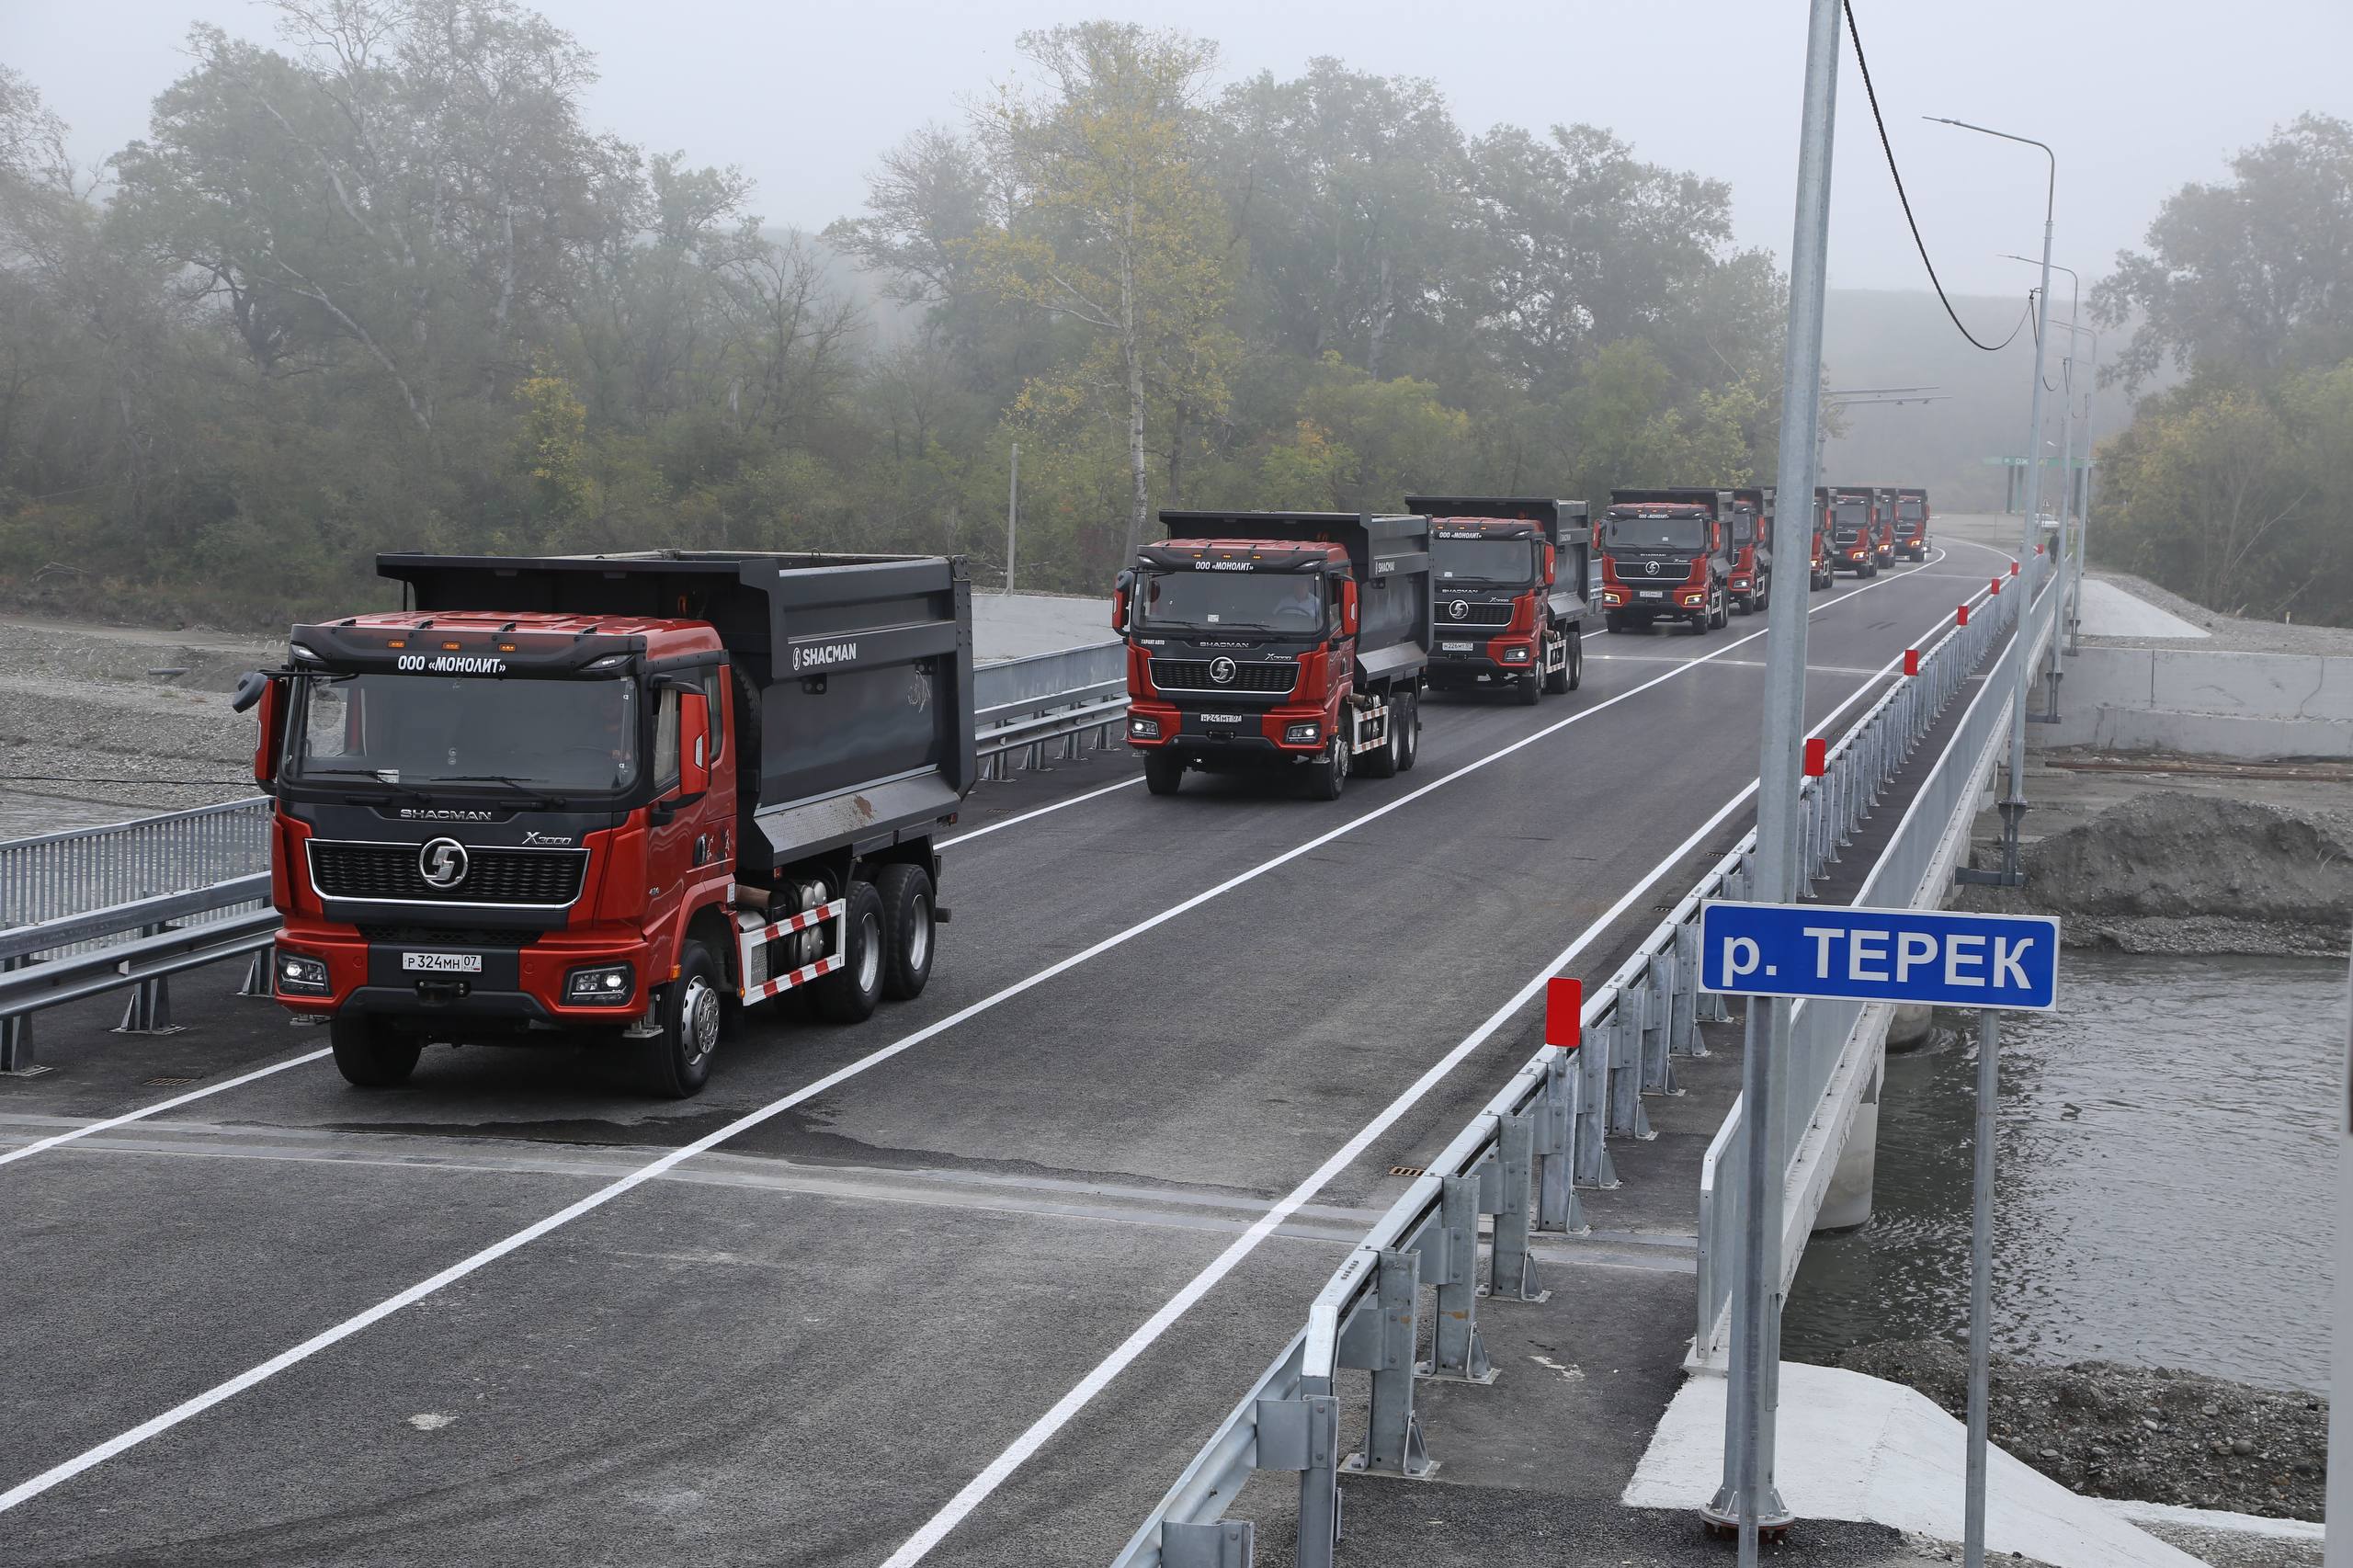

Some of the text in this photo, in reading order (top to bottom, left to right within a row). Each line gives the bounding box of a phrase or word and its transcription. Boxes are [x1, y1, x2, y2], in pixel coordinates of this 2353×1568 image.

[1195, 561, 1254, 571] ООО «МОНОЛИТ»
[802, 642, 857, 667] SHACMAN
[397, 655, 506, 674] ООО «МОНОЛИТ»
[400, 809, 492, 822] SHACMAN
[521, 831, 573, 846] X3000
[1722, 926, 2034, 990] р. ТЕРЕК
